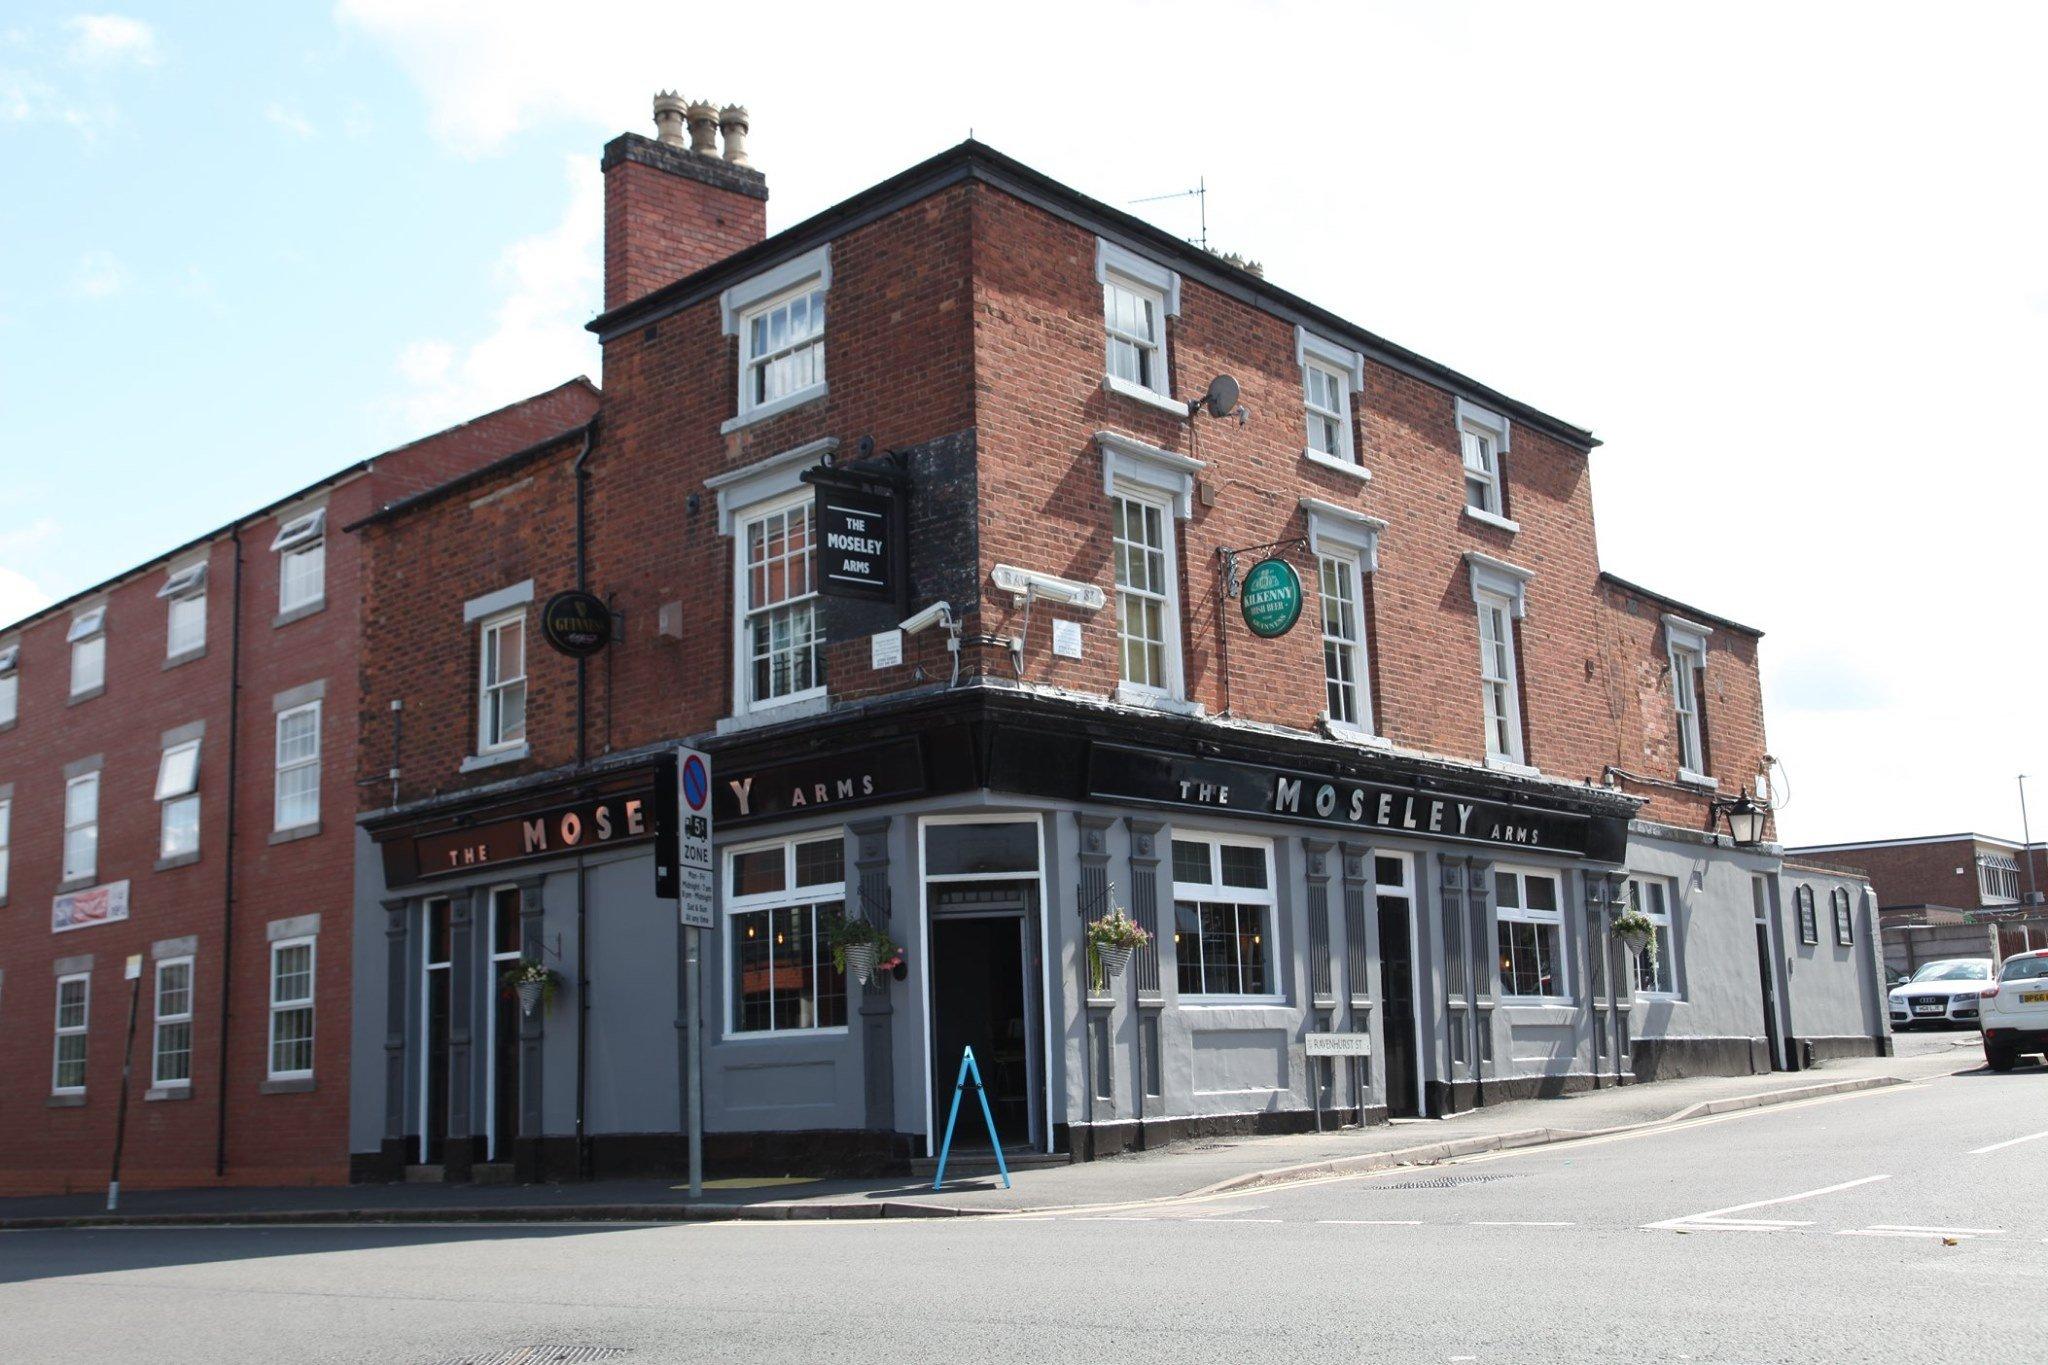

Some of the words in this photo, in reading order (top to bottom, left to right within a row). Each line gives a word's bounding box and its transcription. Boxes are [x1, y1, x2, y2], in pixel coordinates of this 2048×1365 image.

[846, 517, 865, 532] THE
[827, 532, 883, 555] MOSELEY
[843, 559, 870, 574] ARMS
[1244, 586, 1292, 607] KILKENNY
[1267, 602, 1284, 612] BEER
[555, 617, 605, 631] GUINNES
[1179, 780, 1228, 804] THE
[1275, 777, 1474, 834] MOSELEY
[1491, 823, 1539, 845] ARMS
[449, 844, 487, 866] THE
[792, 774, 874, 807] ARMS
[685, 844, 708, 863] ZONE
[1314, 1038, 1353, 1050] RAVENHURST
